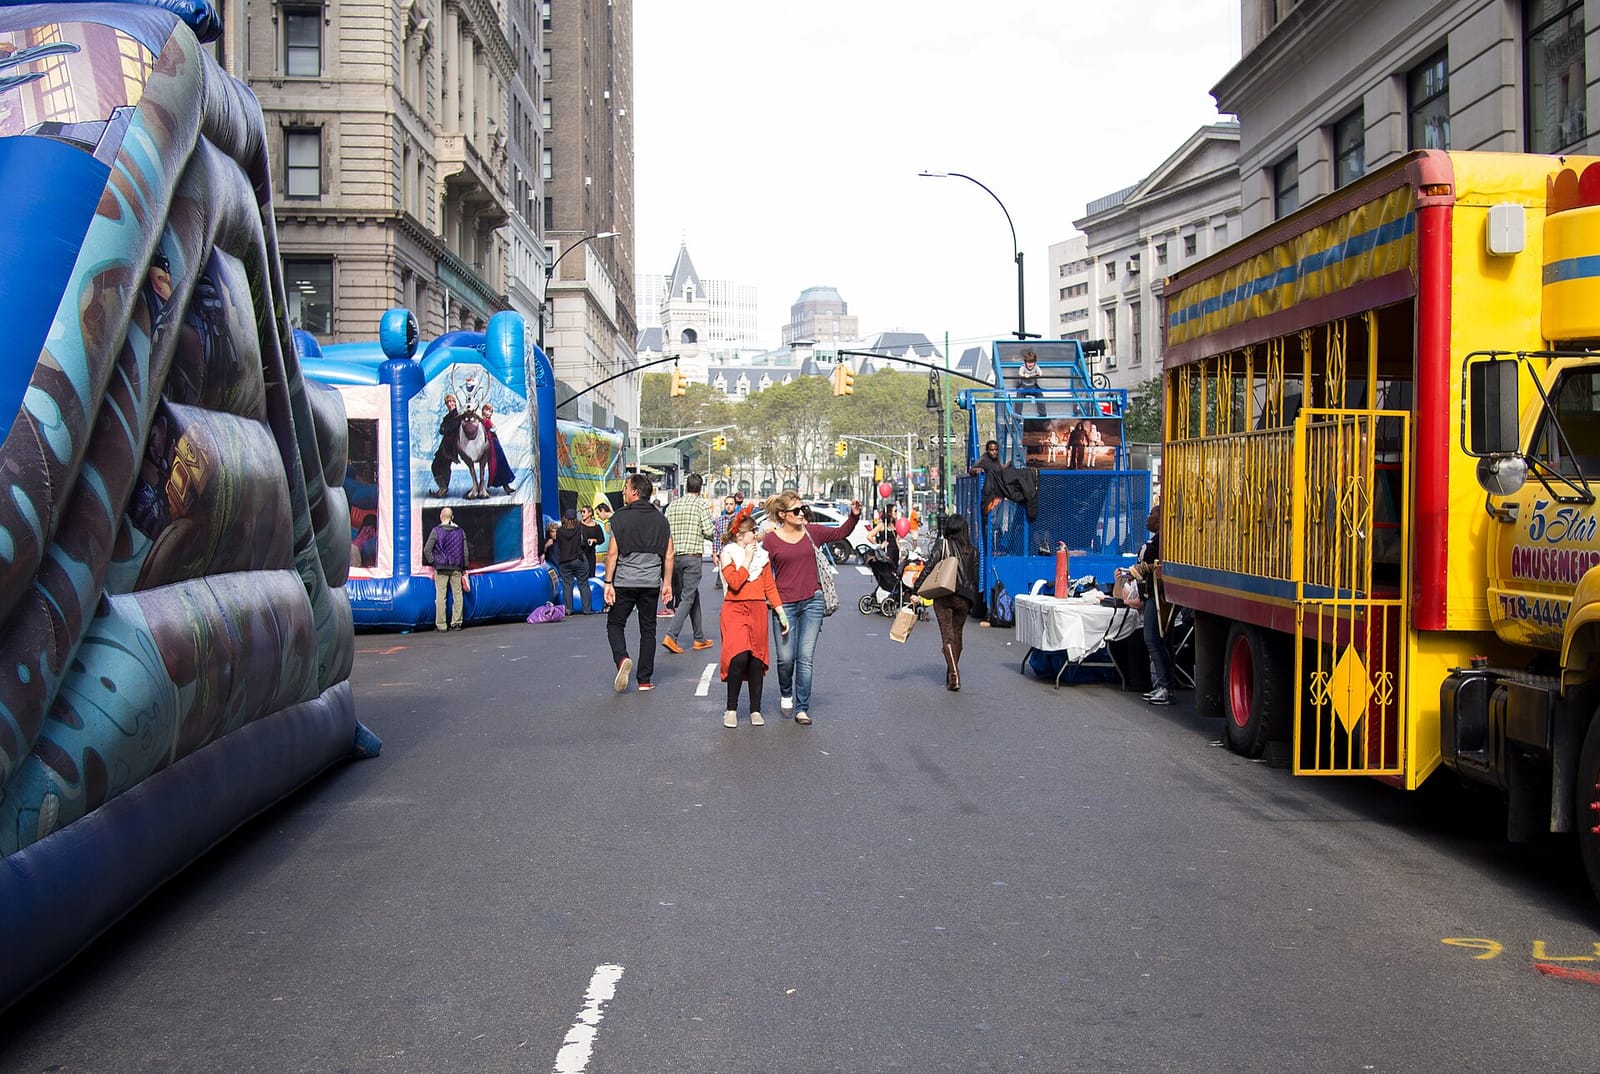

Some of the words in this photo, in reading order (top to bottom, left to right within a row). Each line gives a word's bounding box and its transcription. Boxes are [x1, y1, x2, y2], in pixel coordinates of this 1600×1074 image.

[1529, 499, 1549, 541] 5
[1546, 507, 1597, 544] Star
[1499, 594, 1573, 629] 718-444-
